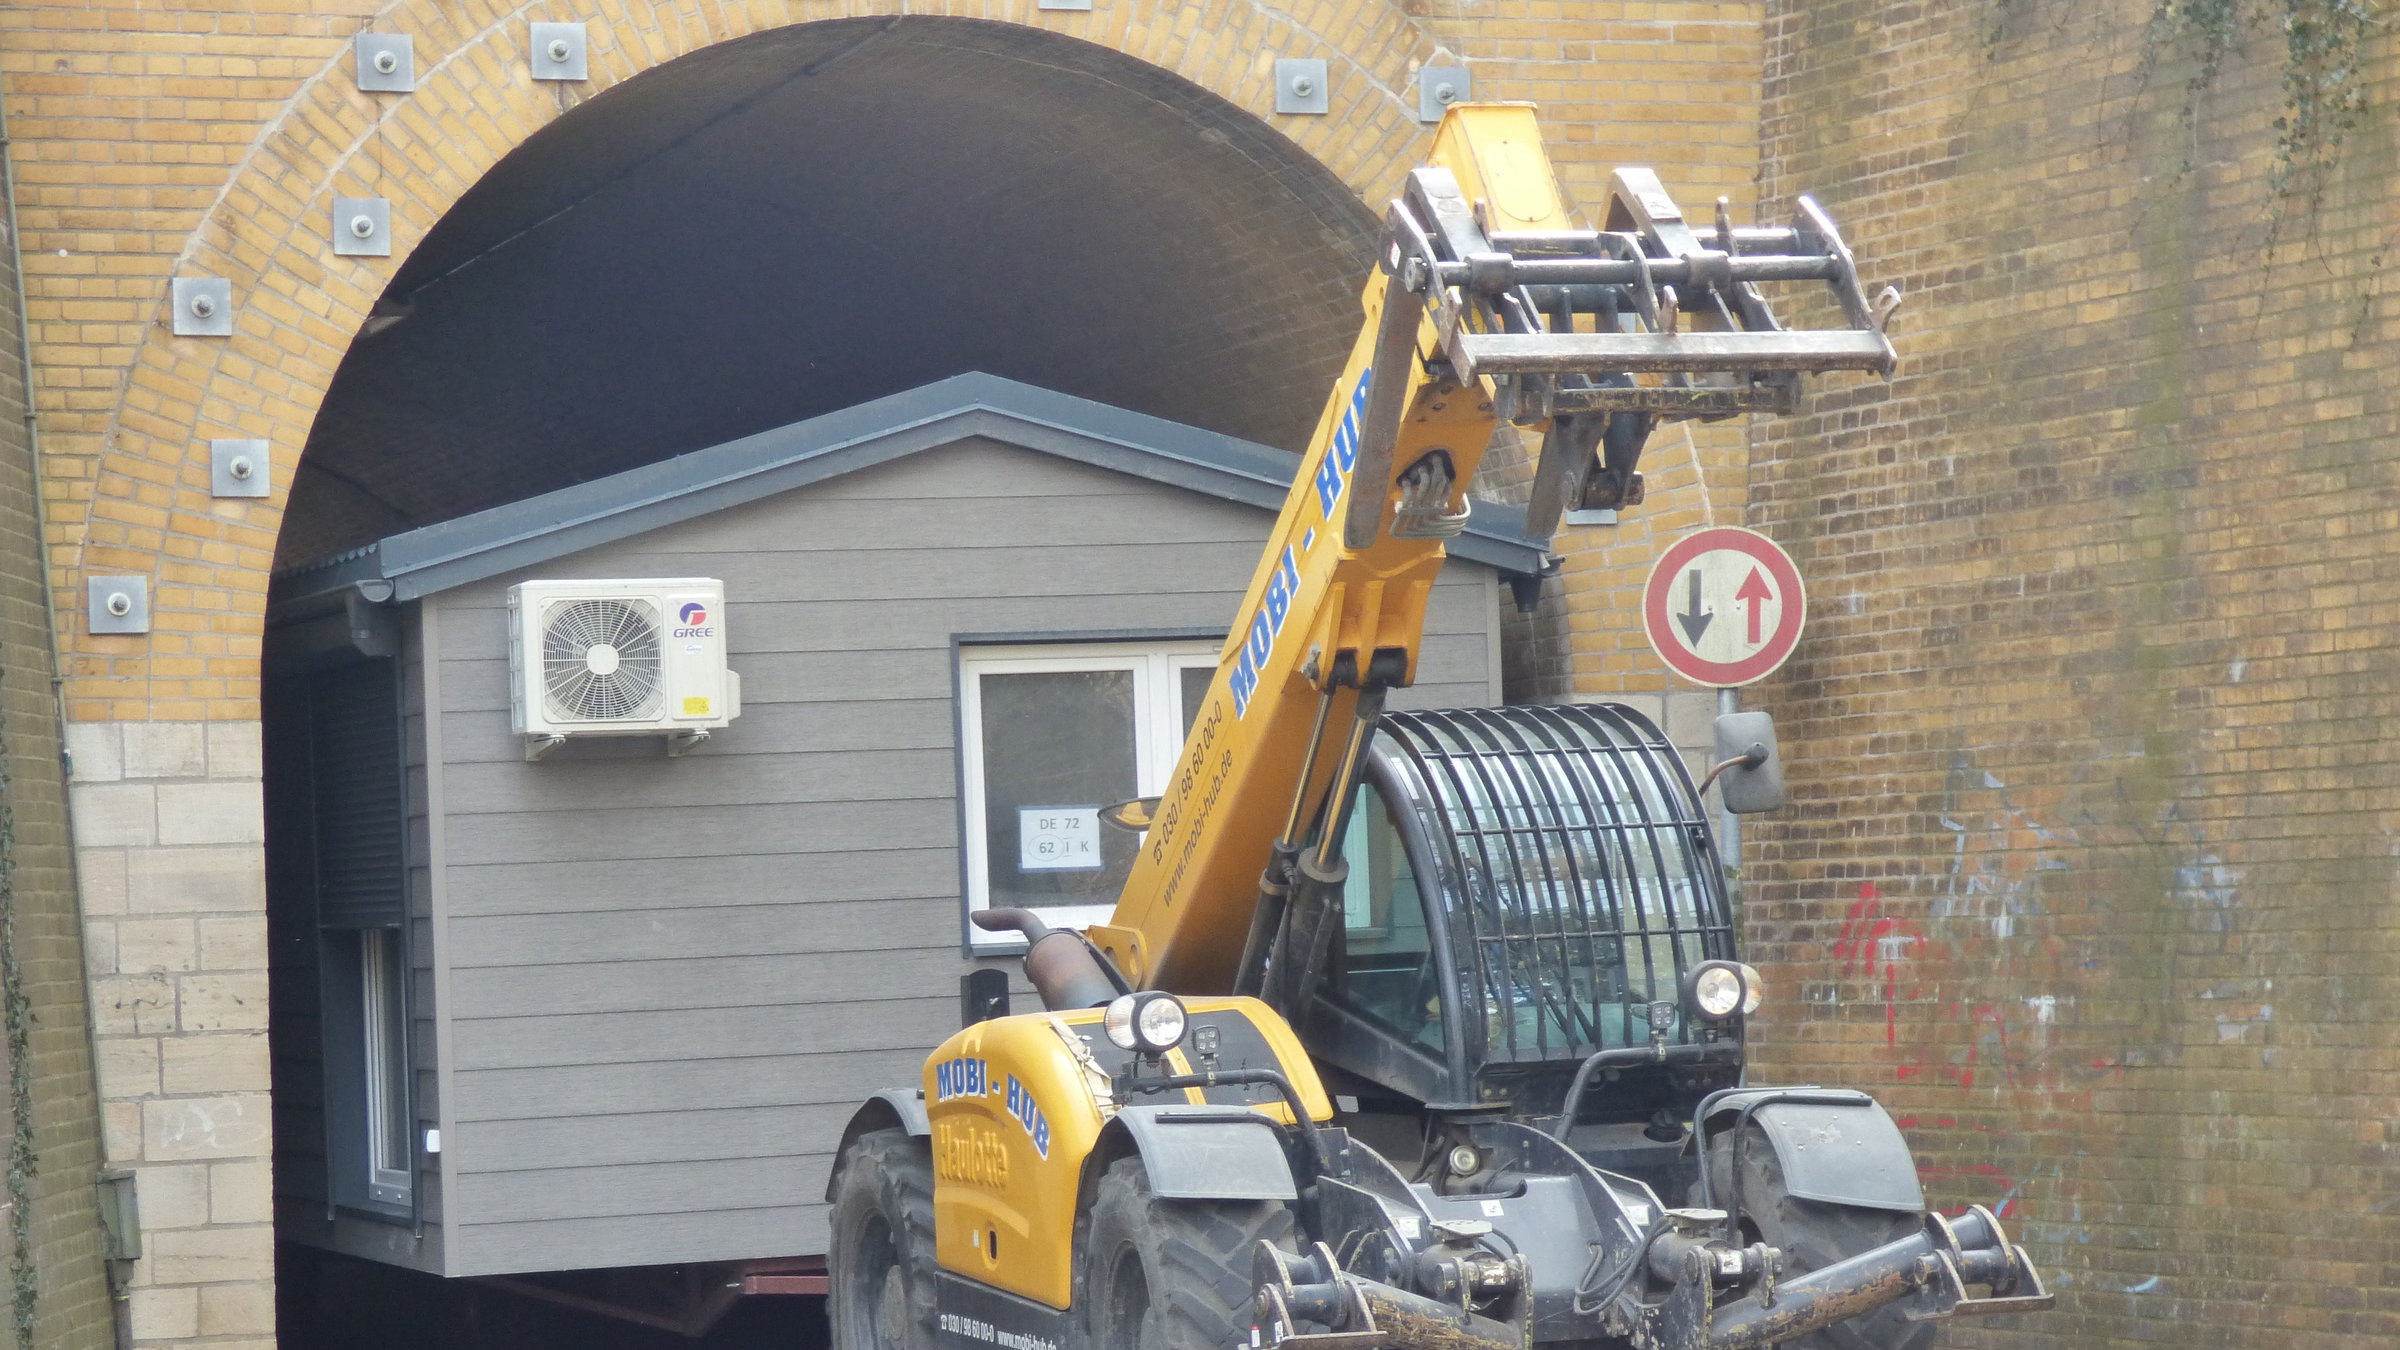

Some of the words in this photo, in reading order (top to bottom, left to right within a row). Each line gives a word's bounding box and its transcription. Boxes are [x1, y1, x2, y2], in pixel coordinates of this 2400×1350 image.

[673, 627, 714, 638] GREE
[1229, 543, 1301, 720] MOBI
[1162, 802, 1179, 844] 030
[1181, 768, 1193, 801] 98
[1192, 743, 1204, 775] 60
[1203, 700, 1222, 750] 00-0
[1039, 842, 1055, 853] 62
[1081, 841, 1089, 852] K
[1040, 818, 1057, 830] DE
[1064, 817, 1080, 829] 72
[1163, 749, 1233, 907] www.mobi-hub.de
[936, 1057, 988, 1103] MOBI
[1006, 1072, 1050, 1161] HUB
[948, 1313, 960, 1334] 030
[963, 1317, 972, 1337] 98
[972, 1320, 980, 1339] 60
[980, 1321, 995, 1343] 00-0
